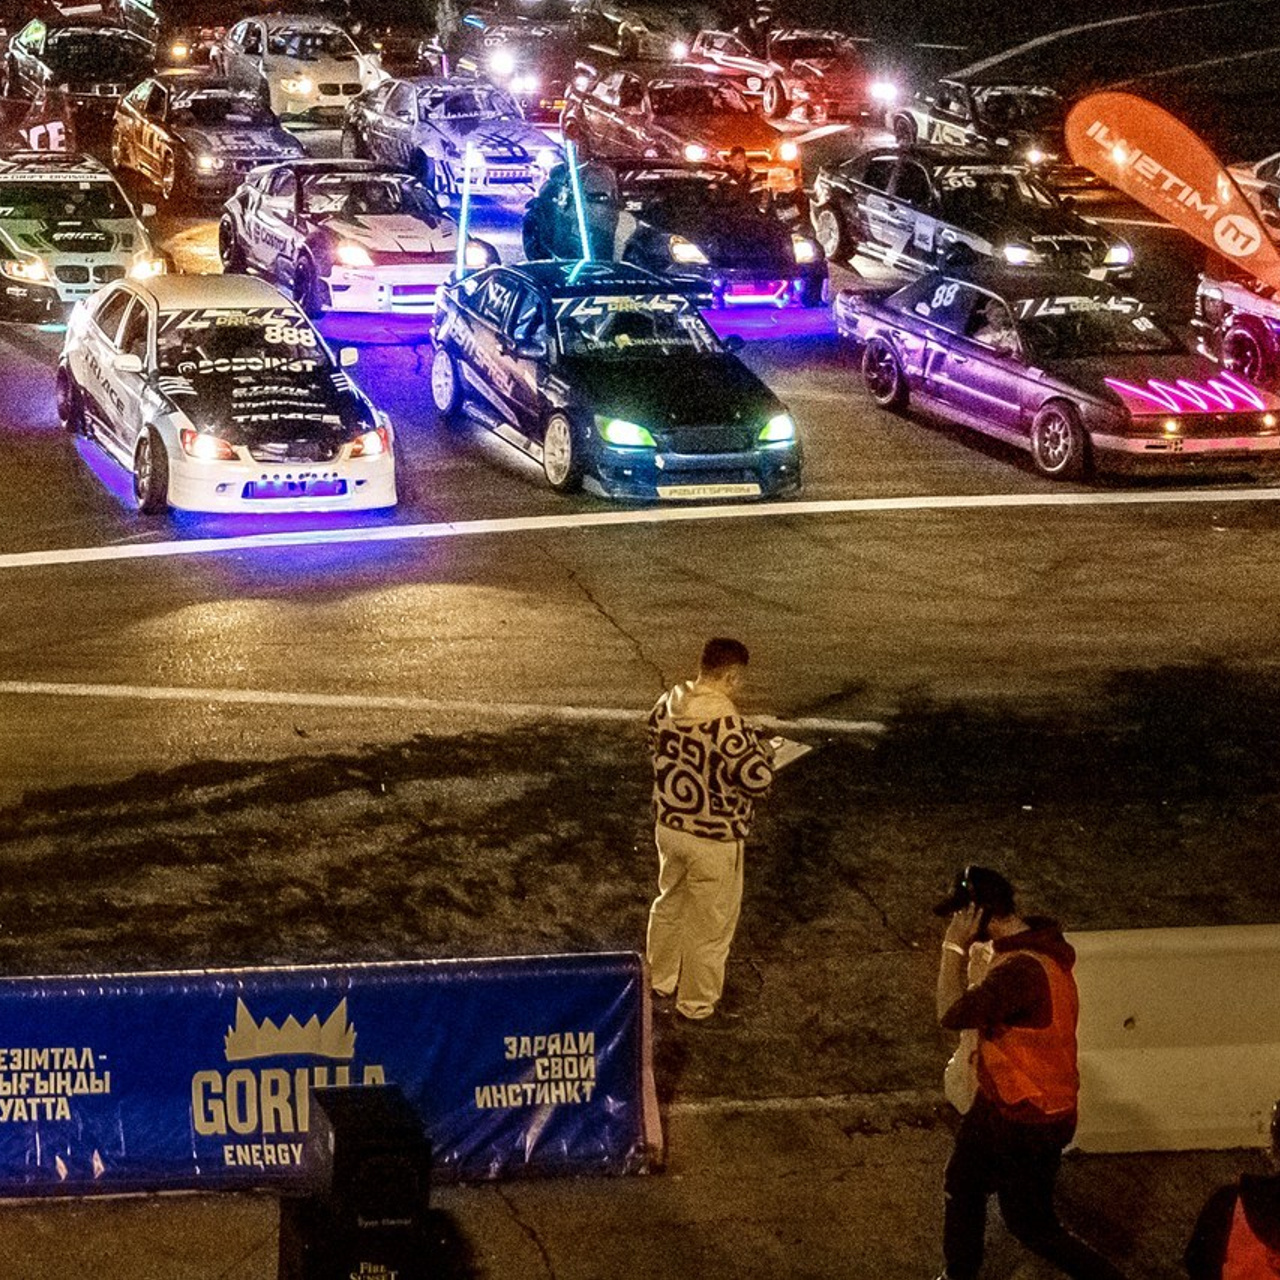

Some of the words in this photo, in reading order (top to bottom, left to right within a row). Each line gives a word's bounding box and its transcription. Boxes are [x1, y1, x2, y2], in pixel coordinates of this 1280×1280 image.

[931, 282, 960, 308] 88
[264, 326, 318, 347] 888
[1132, 316, 1155, 332] 88
[504, 1032, 595, 1059] ЗАРЯДИ
[535, 1055, 595, 1080] СВОЙ
[191, 1065, 385, 1135] GORI
[475, 1081, 596, 1109] ИНСТИНКТ
[223, 1143, 303, 1166] ENERGY
